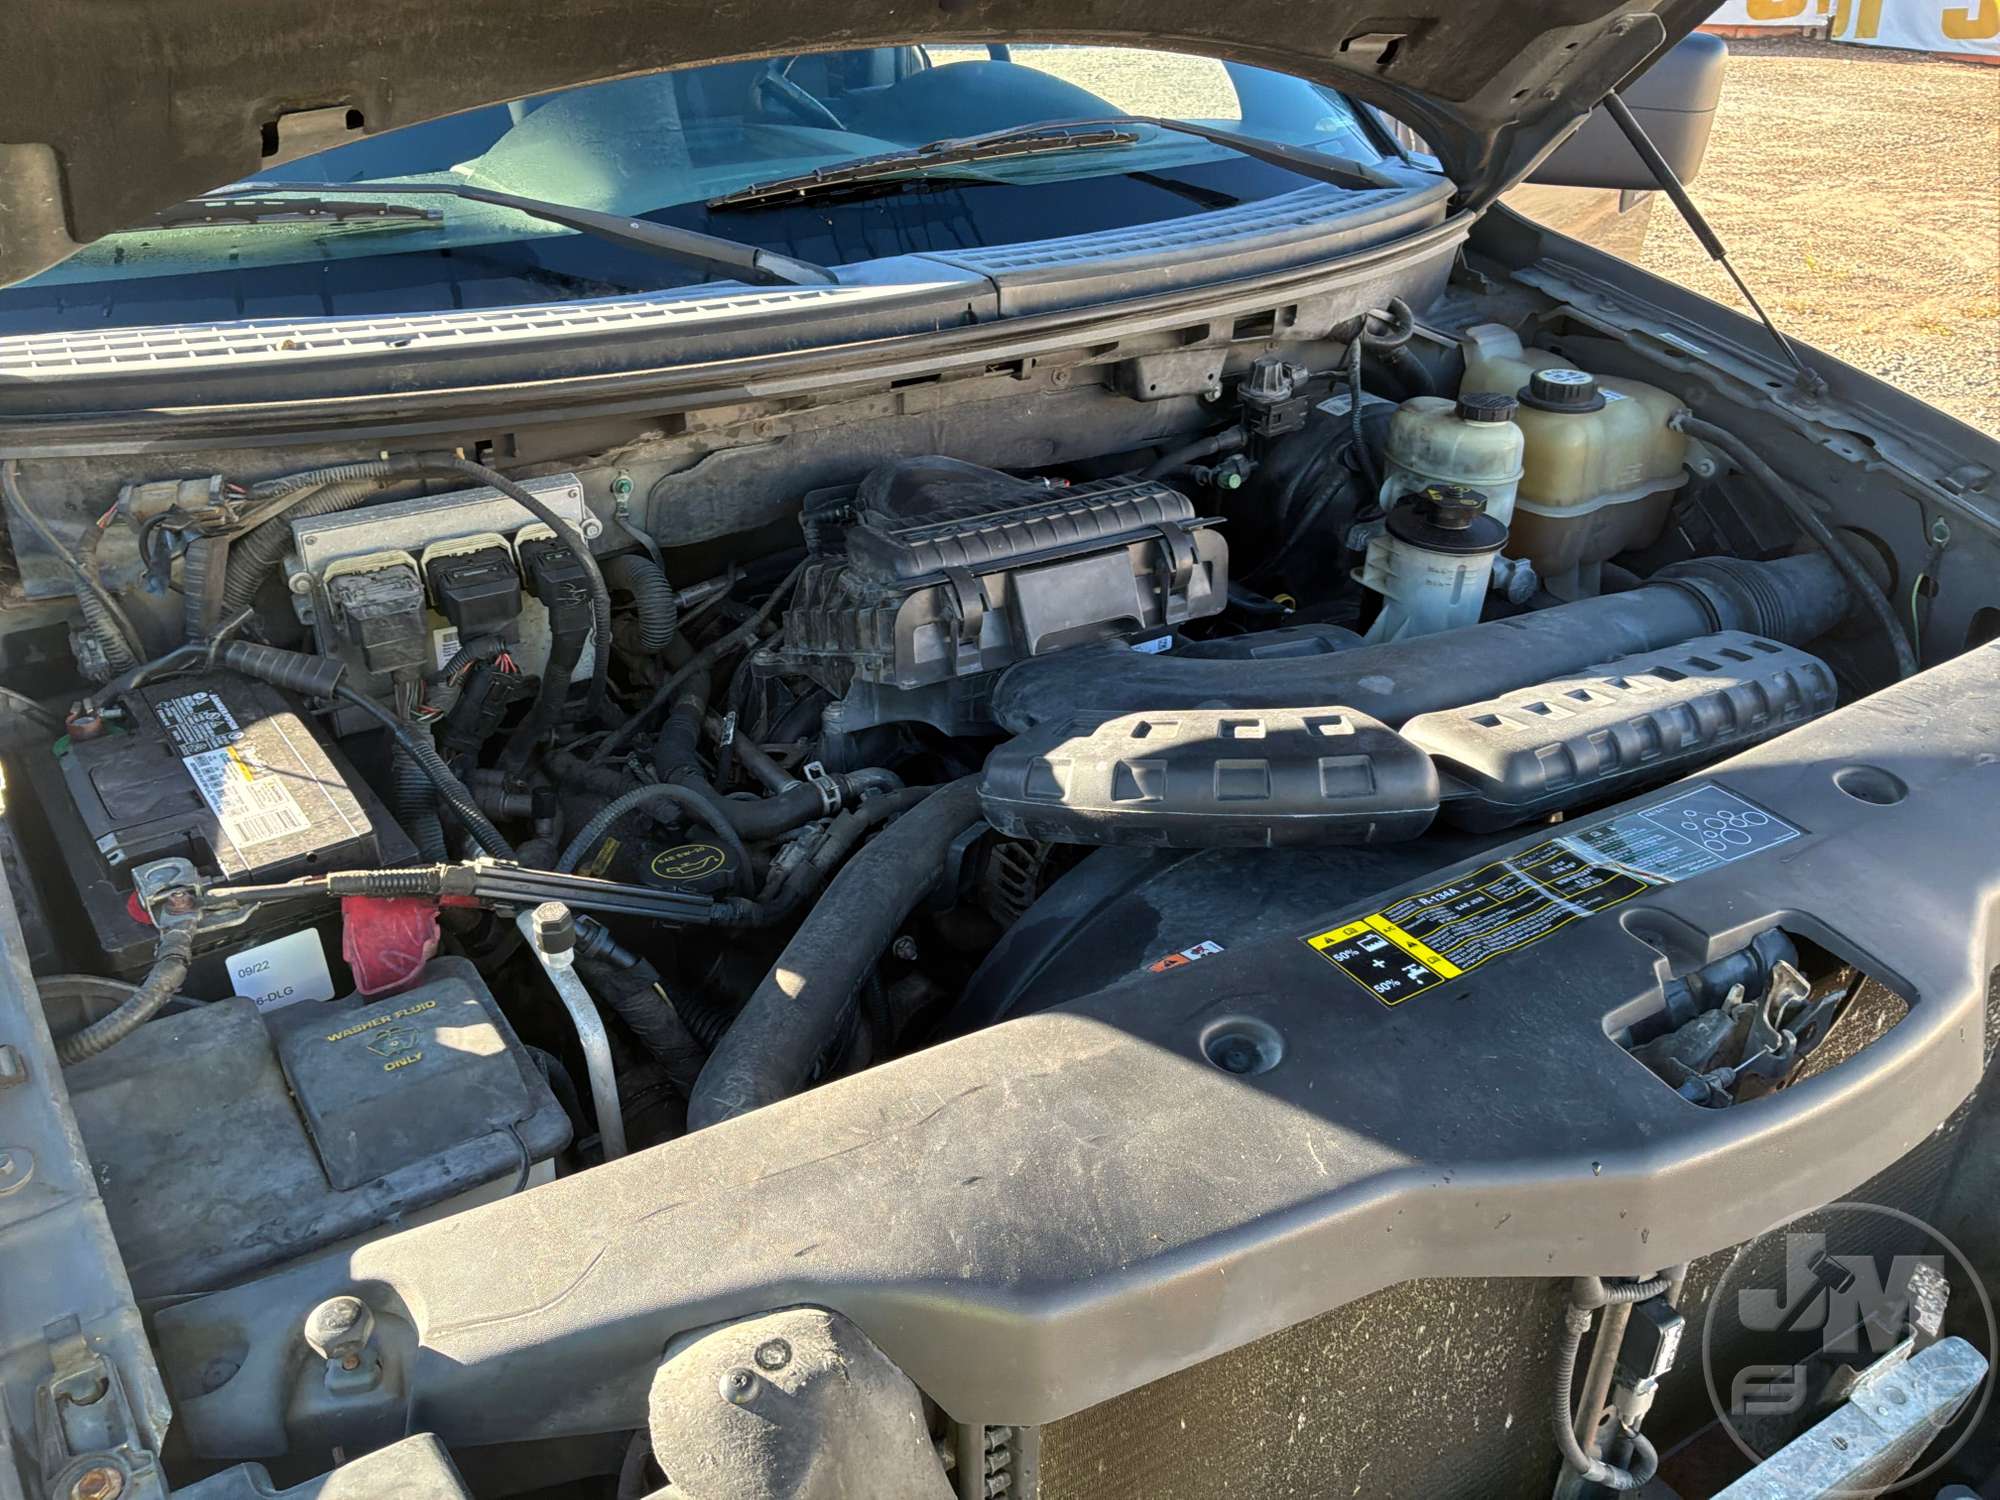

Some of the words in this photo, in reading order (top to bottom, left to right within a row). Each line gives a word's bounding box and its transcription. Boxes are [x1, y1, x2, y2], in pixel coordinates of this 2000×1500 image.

[1418, 888, 1461, 906] R-134A
[1332, 948, 1360, 962] 50%
[238, 960, 270, 978] 09/22
[1373, 978, 1401, 994] 50%
[255, 986, 294, 1006] 6-DLG
[327, 1015, 392, 1042] WASHER
[392, 1000, 437, 1019] FLUID
[383, 1051, 423, 1072] ONLY
